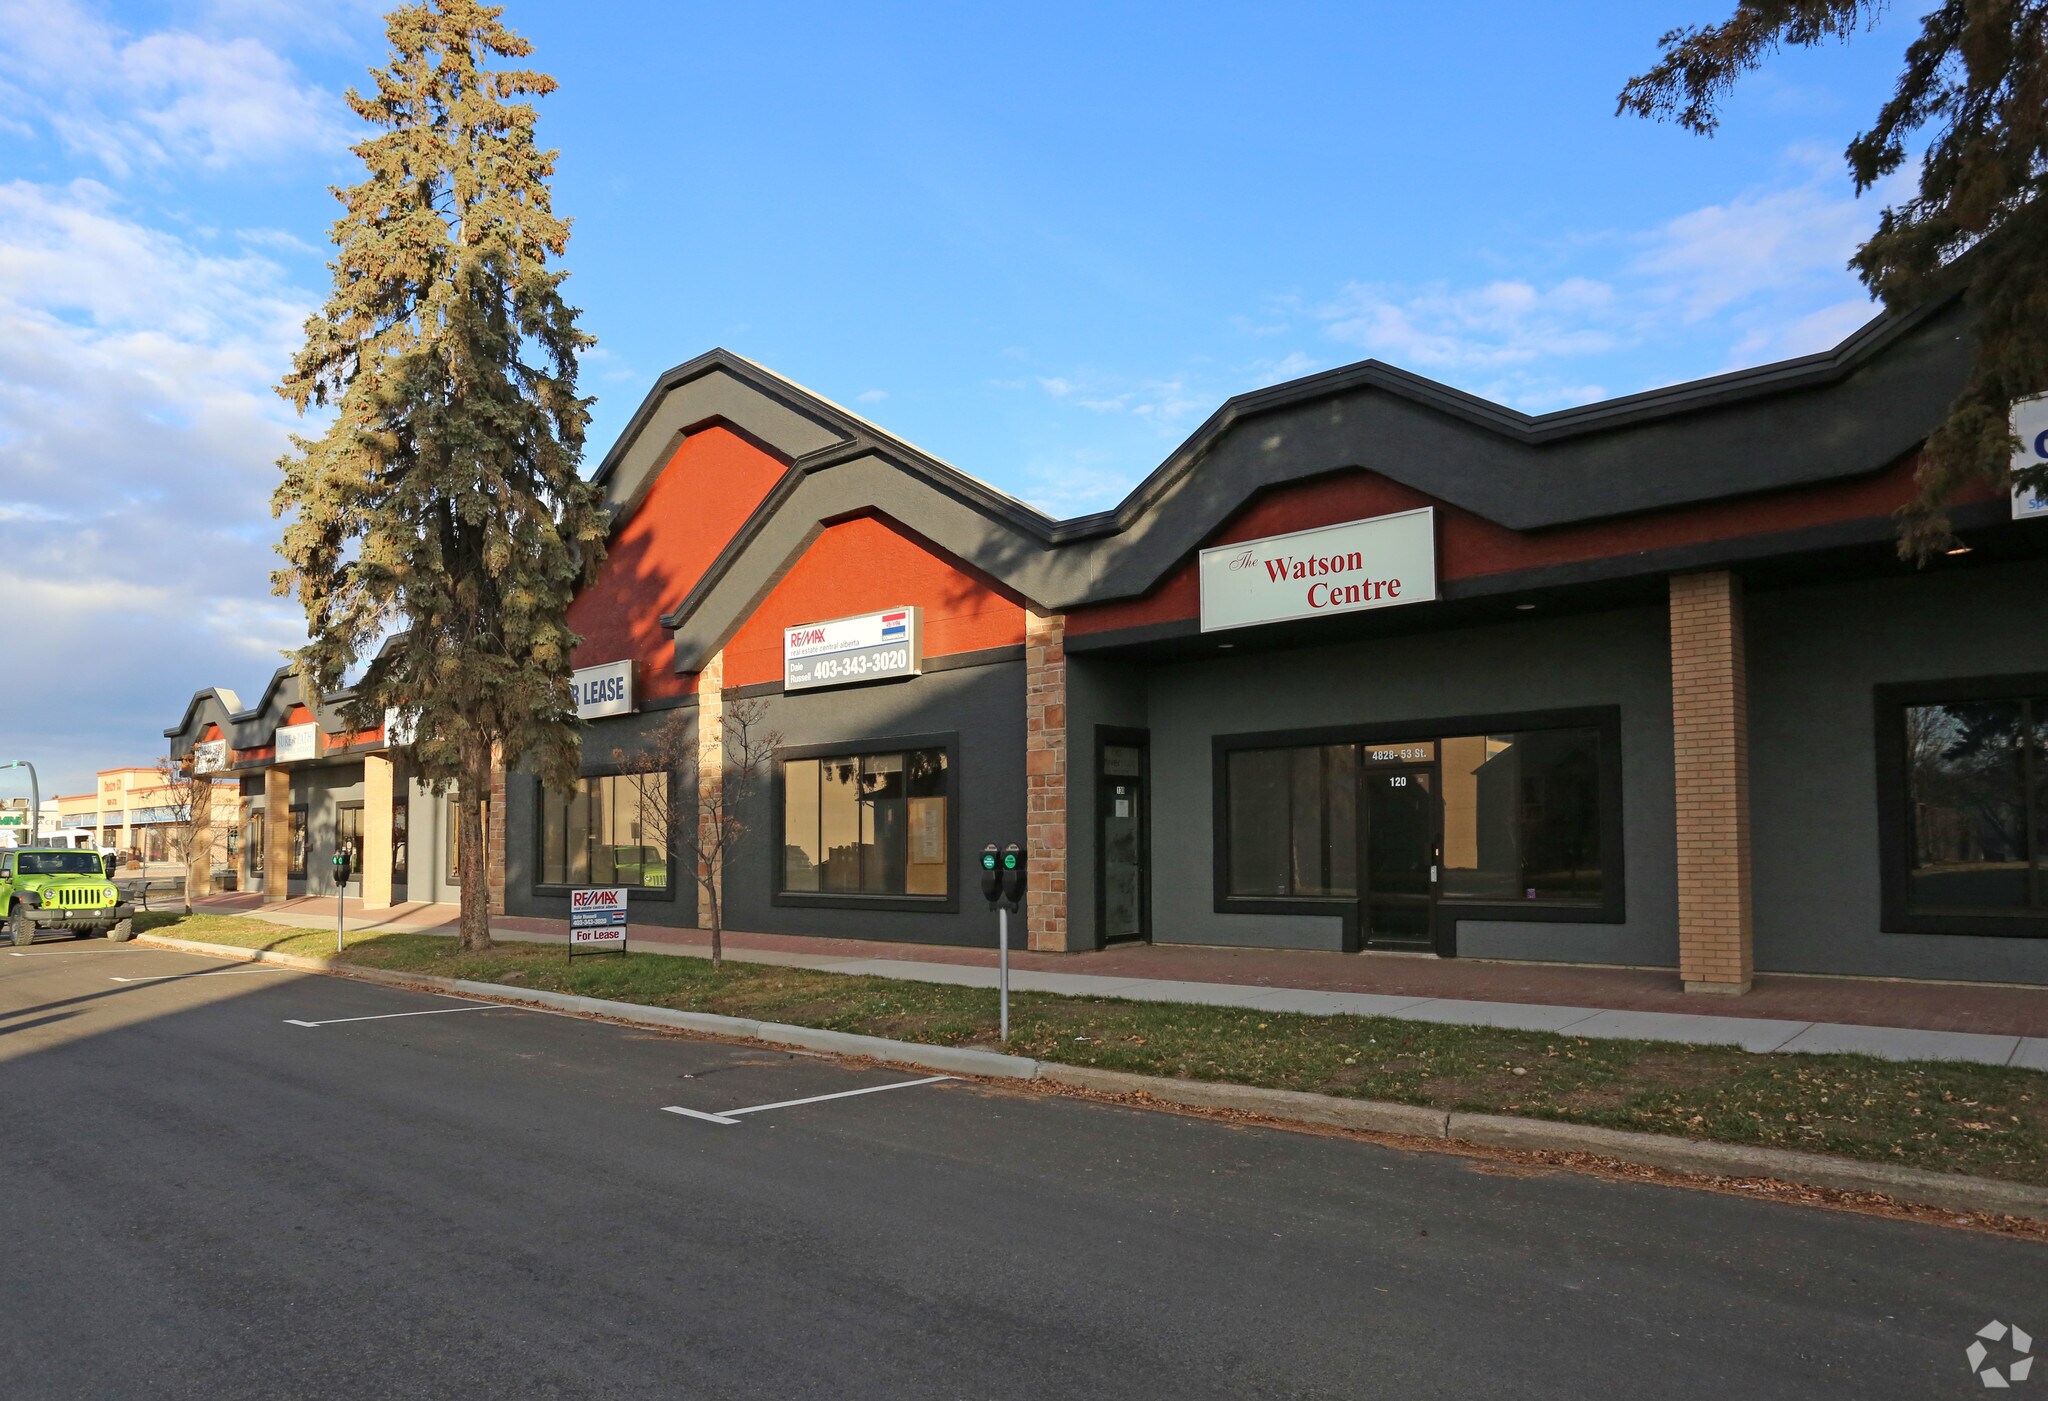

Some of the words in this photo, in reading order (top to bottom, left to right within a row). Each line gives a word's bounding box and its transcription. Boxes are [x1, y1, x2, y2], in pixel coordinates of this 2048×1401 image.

[1229, 550, 1259, 571] The
[1264, 551, 1363, 583] Watson
[1307, 577, 1402, 608] Centre
[791, 628, 826, 648] RE/MAX
[802, 646, 819, 655] estate
[820, 642, 839, 652] central
[840, 640, 860, 649] alberta
[790, 663, 804, 672] Dale
[814, 649, 907, 680] 403-343-3020
[790, 672, 812, 684] Russell
[583, 676, 624, 705] LEASE
[1372, 750, 1398, 760] 4828-
[1401, 749, 1412, 759] 53
[1414, 748, 1427, 758] St.
[1389, 776, 1407, 787] 120
[574, 891, 618, 906] RE/MAX
[577, 931, 591, 940] For
[594, 930, 619, 939] Lease
